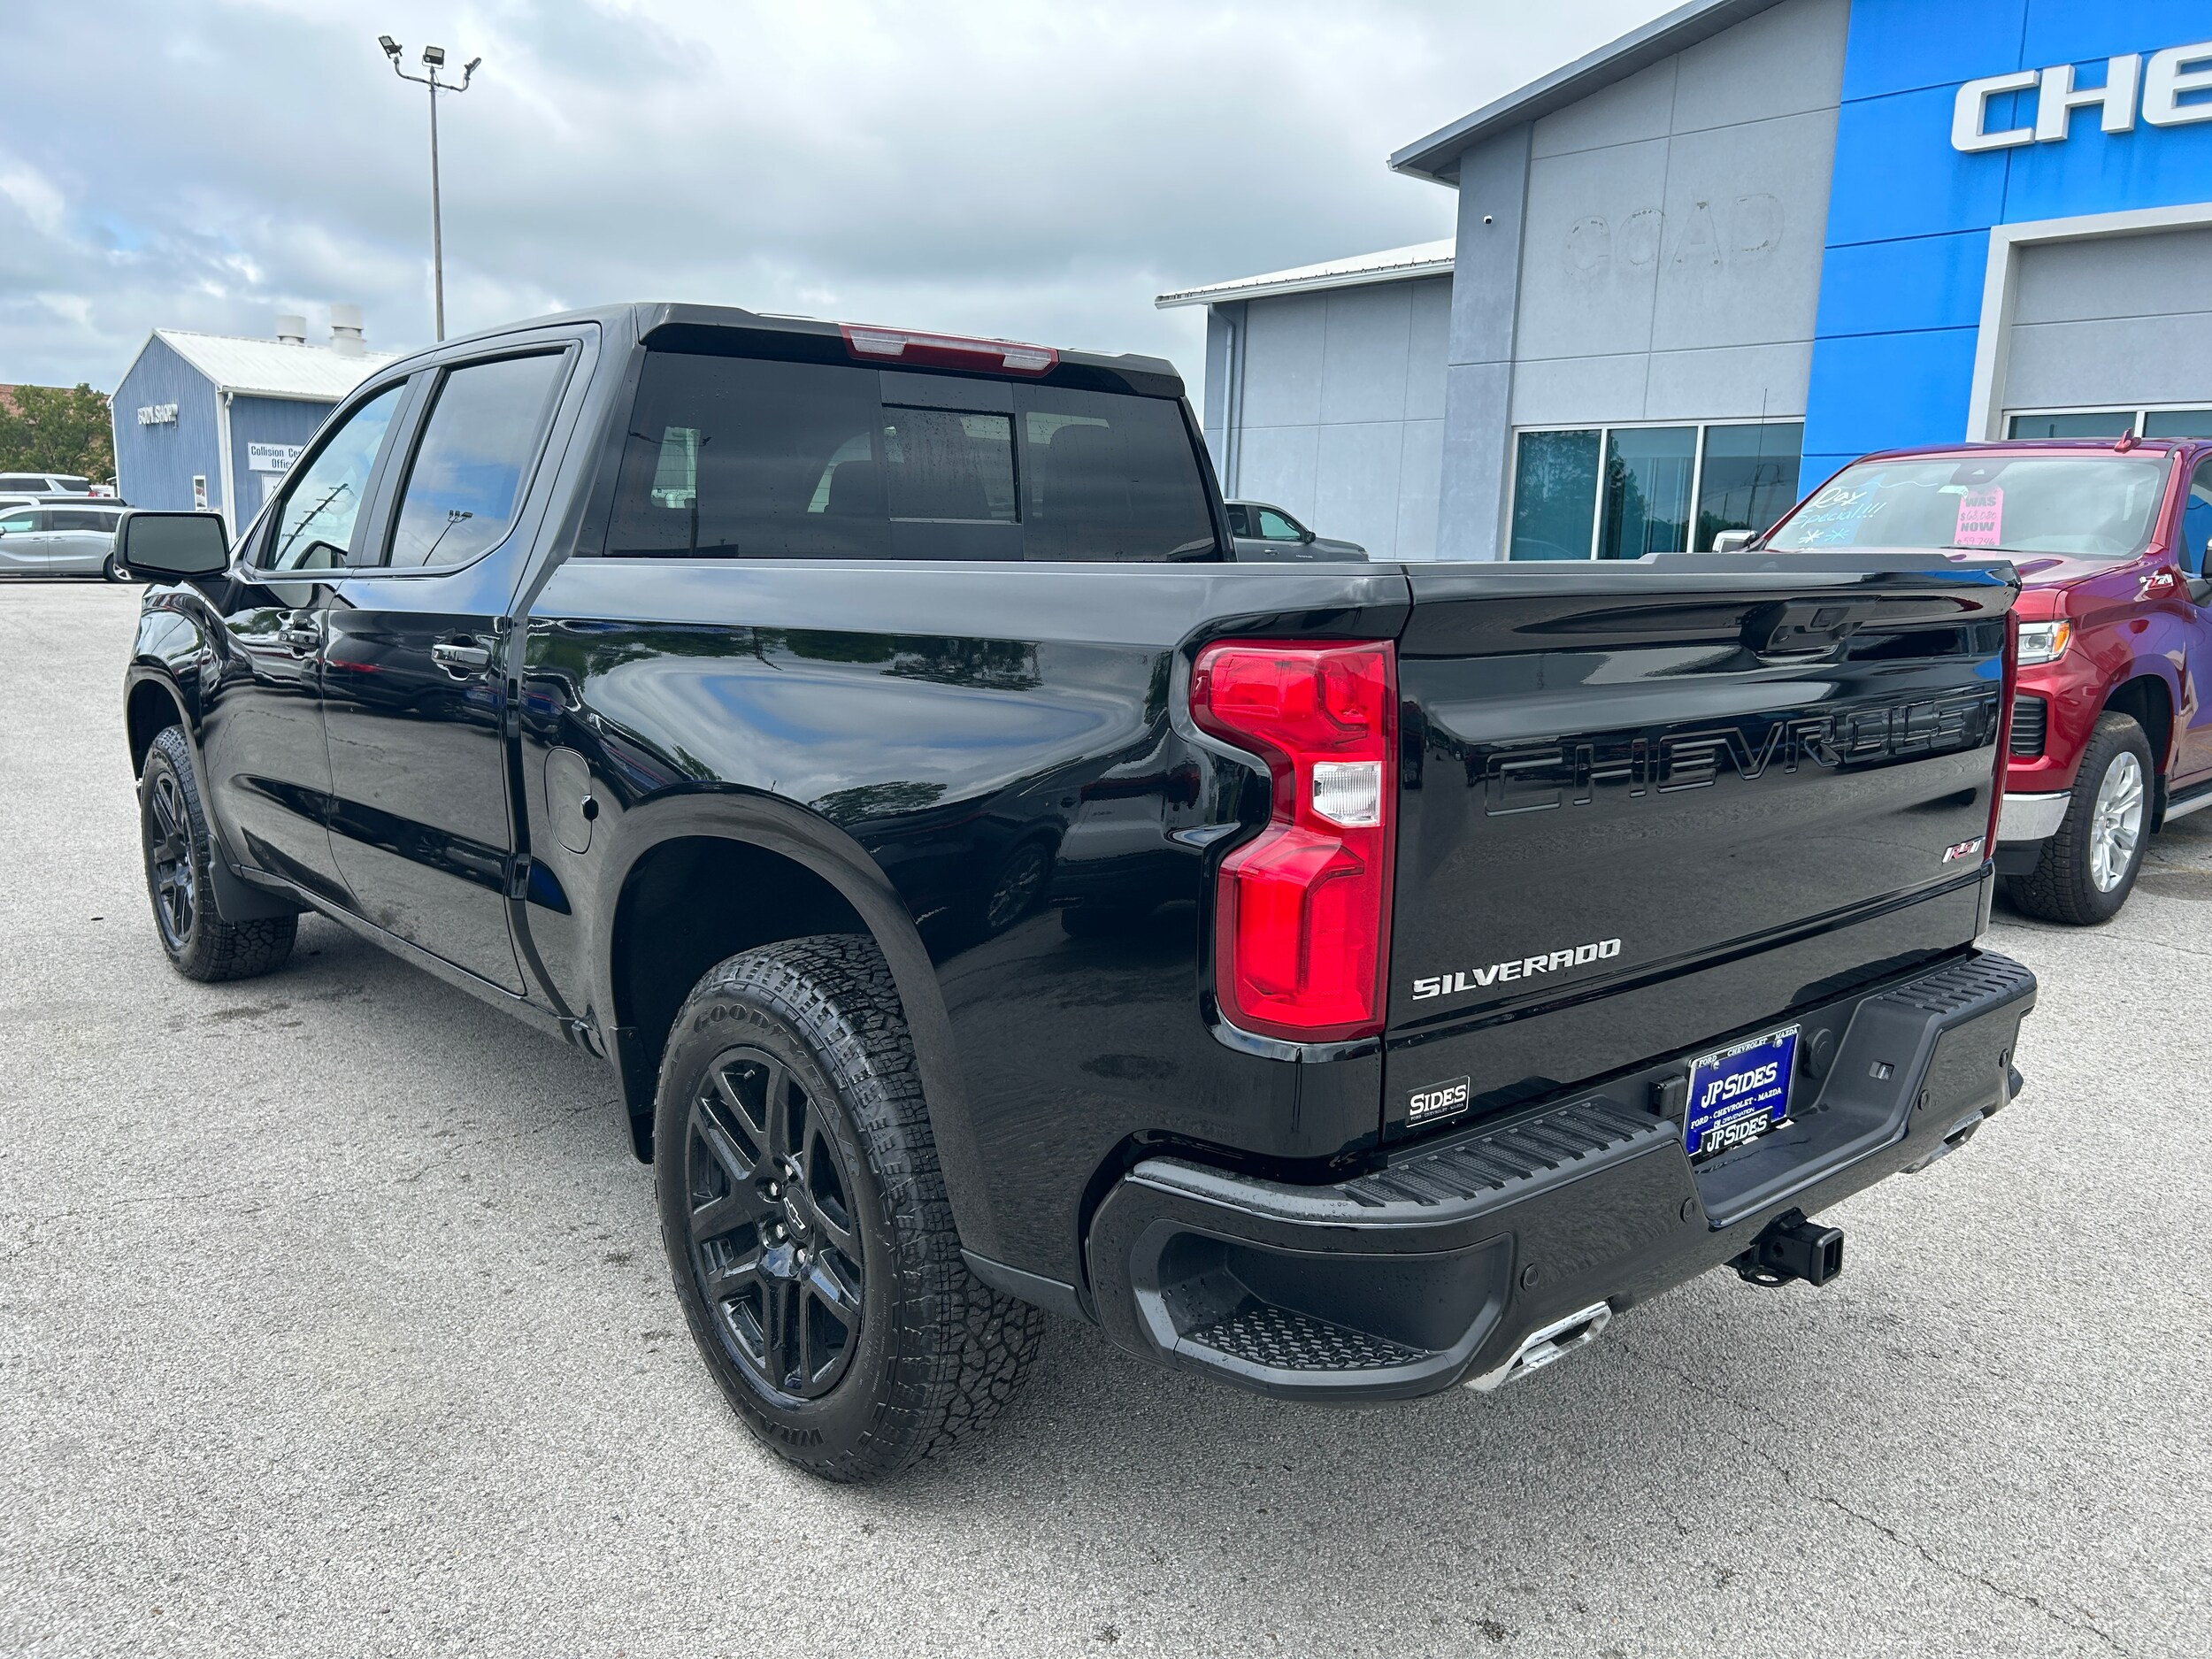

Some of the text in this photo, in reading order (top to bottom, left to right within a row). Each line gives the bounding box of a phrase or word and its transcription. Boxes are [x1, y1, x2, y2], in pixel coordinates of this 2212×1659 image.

[155, 403, 174, 423] SHOP
[251, 446, 301, 458] Collision Ce
[272, 458, 293, 469] Offic
[1965, 496, 1996, 508] WAS
[1961, 521, 1995, 532] NOW
[1942, 835, 1985, 863] RST
[1412, 938, 1622, 1001] SILVERADO
[1698, 1027, 1798, 1067] FORD CHEVROLET MAZDA
[1409, 1085, 1466, 1115] SIDES
[1691, 1115, 1709, 1129] FORD
[1713, 1097, 1753, 1118] CHEVROLET
[1757, 1087, 1782, 1102] MAZDA
